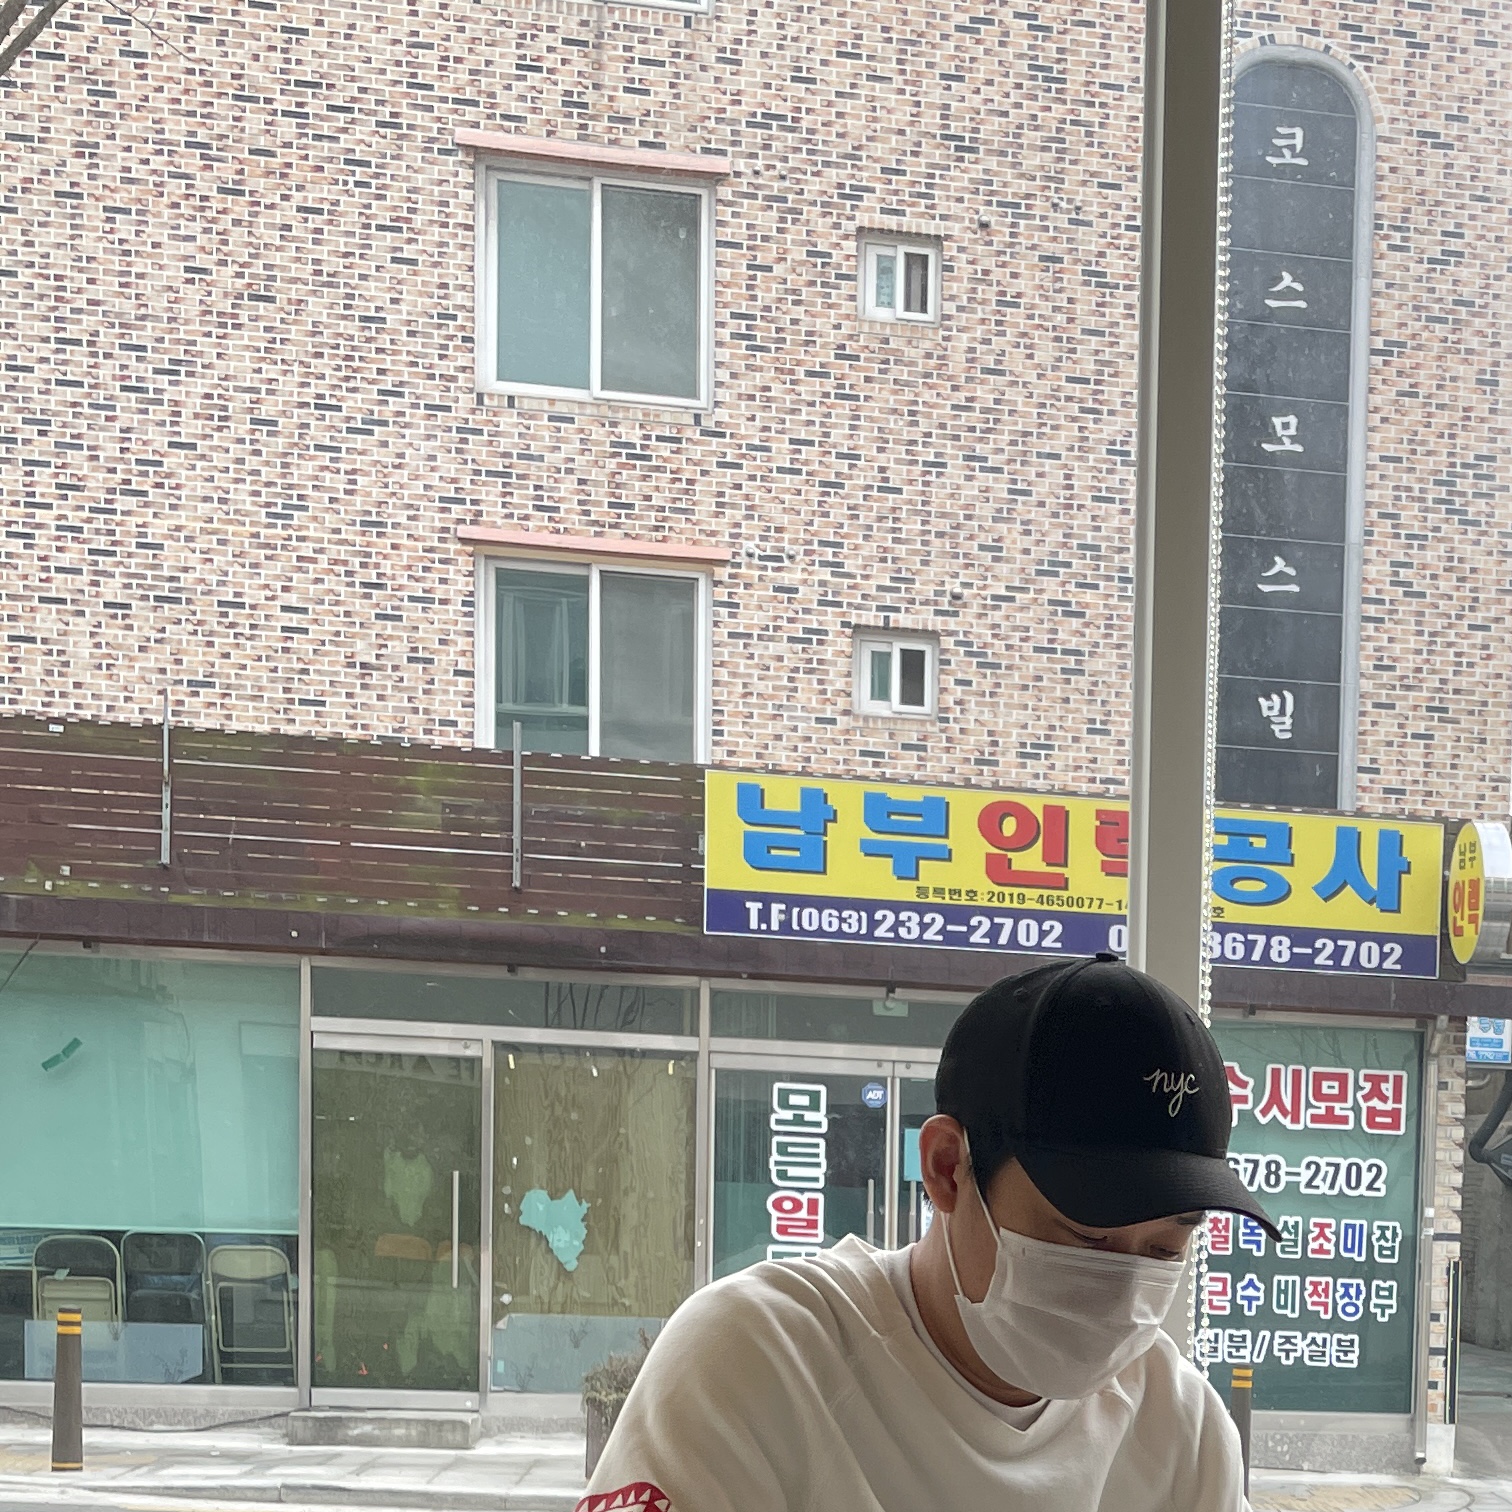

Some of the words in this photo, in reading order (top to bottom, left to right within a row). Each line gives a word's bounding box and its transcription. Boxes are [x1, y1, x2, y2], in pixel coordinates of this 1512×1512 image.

[1258, 125, 1309, 740] 코스모스빌
[873, 909, 1063, 949] 232-2702
[866, 1089, 885, 1101] ADT
[1143, 1068, 1200, 1118] nyc
